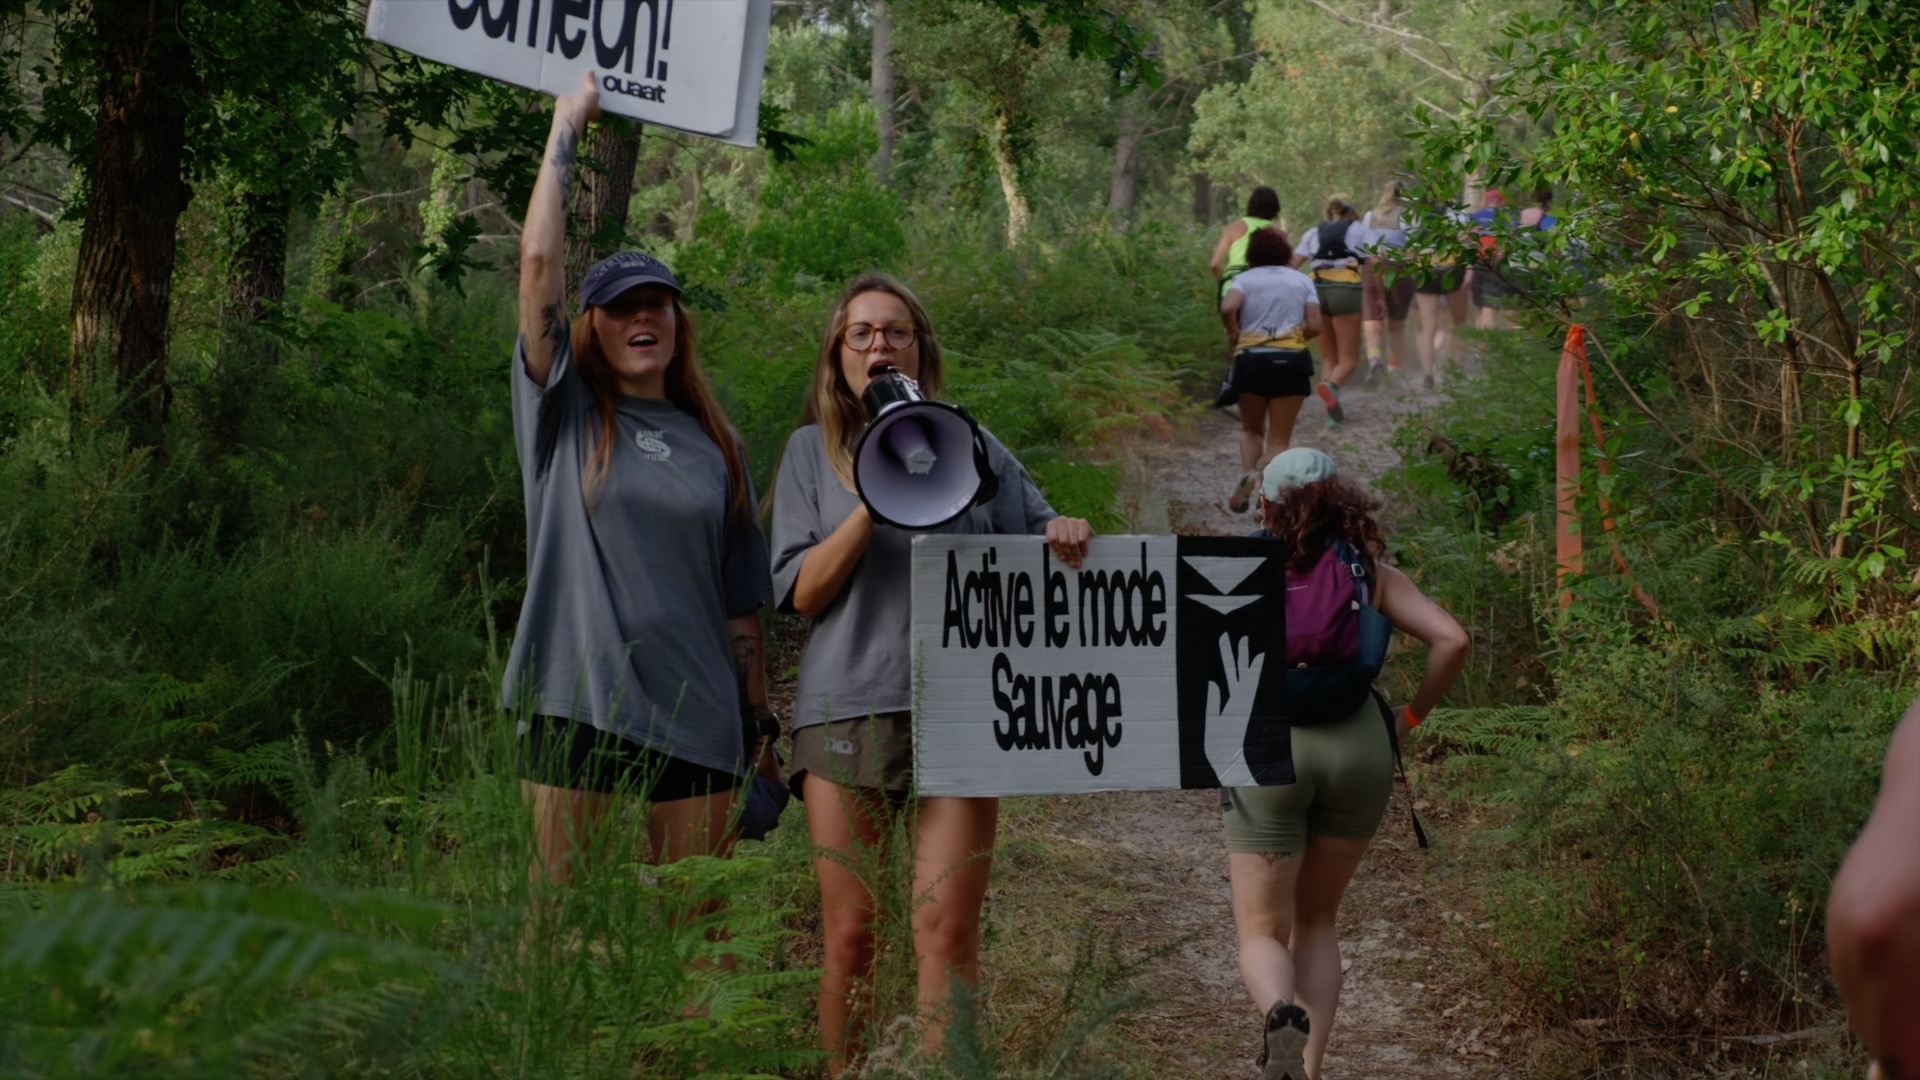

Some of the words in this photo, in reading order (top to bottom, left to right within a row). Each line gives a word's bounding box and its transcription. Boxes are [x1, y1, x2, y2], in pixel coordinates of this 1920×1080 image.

[602, 75, 666, 103] ouaat
[942, 547, 1035, 648] Active
[1043, 542, 1070, 648] le
[1078, 541, 1167, 647] mode
[992, 652, 1122, 776] Sauvage
